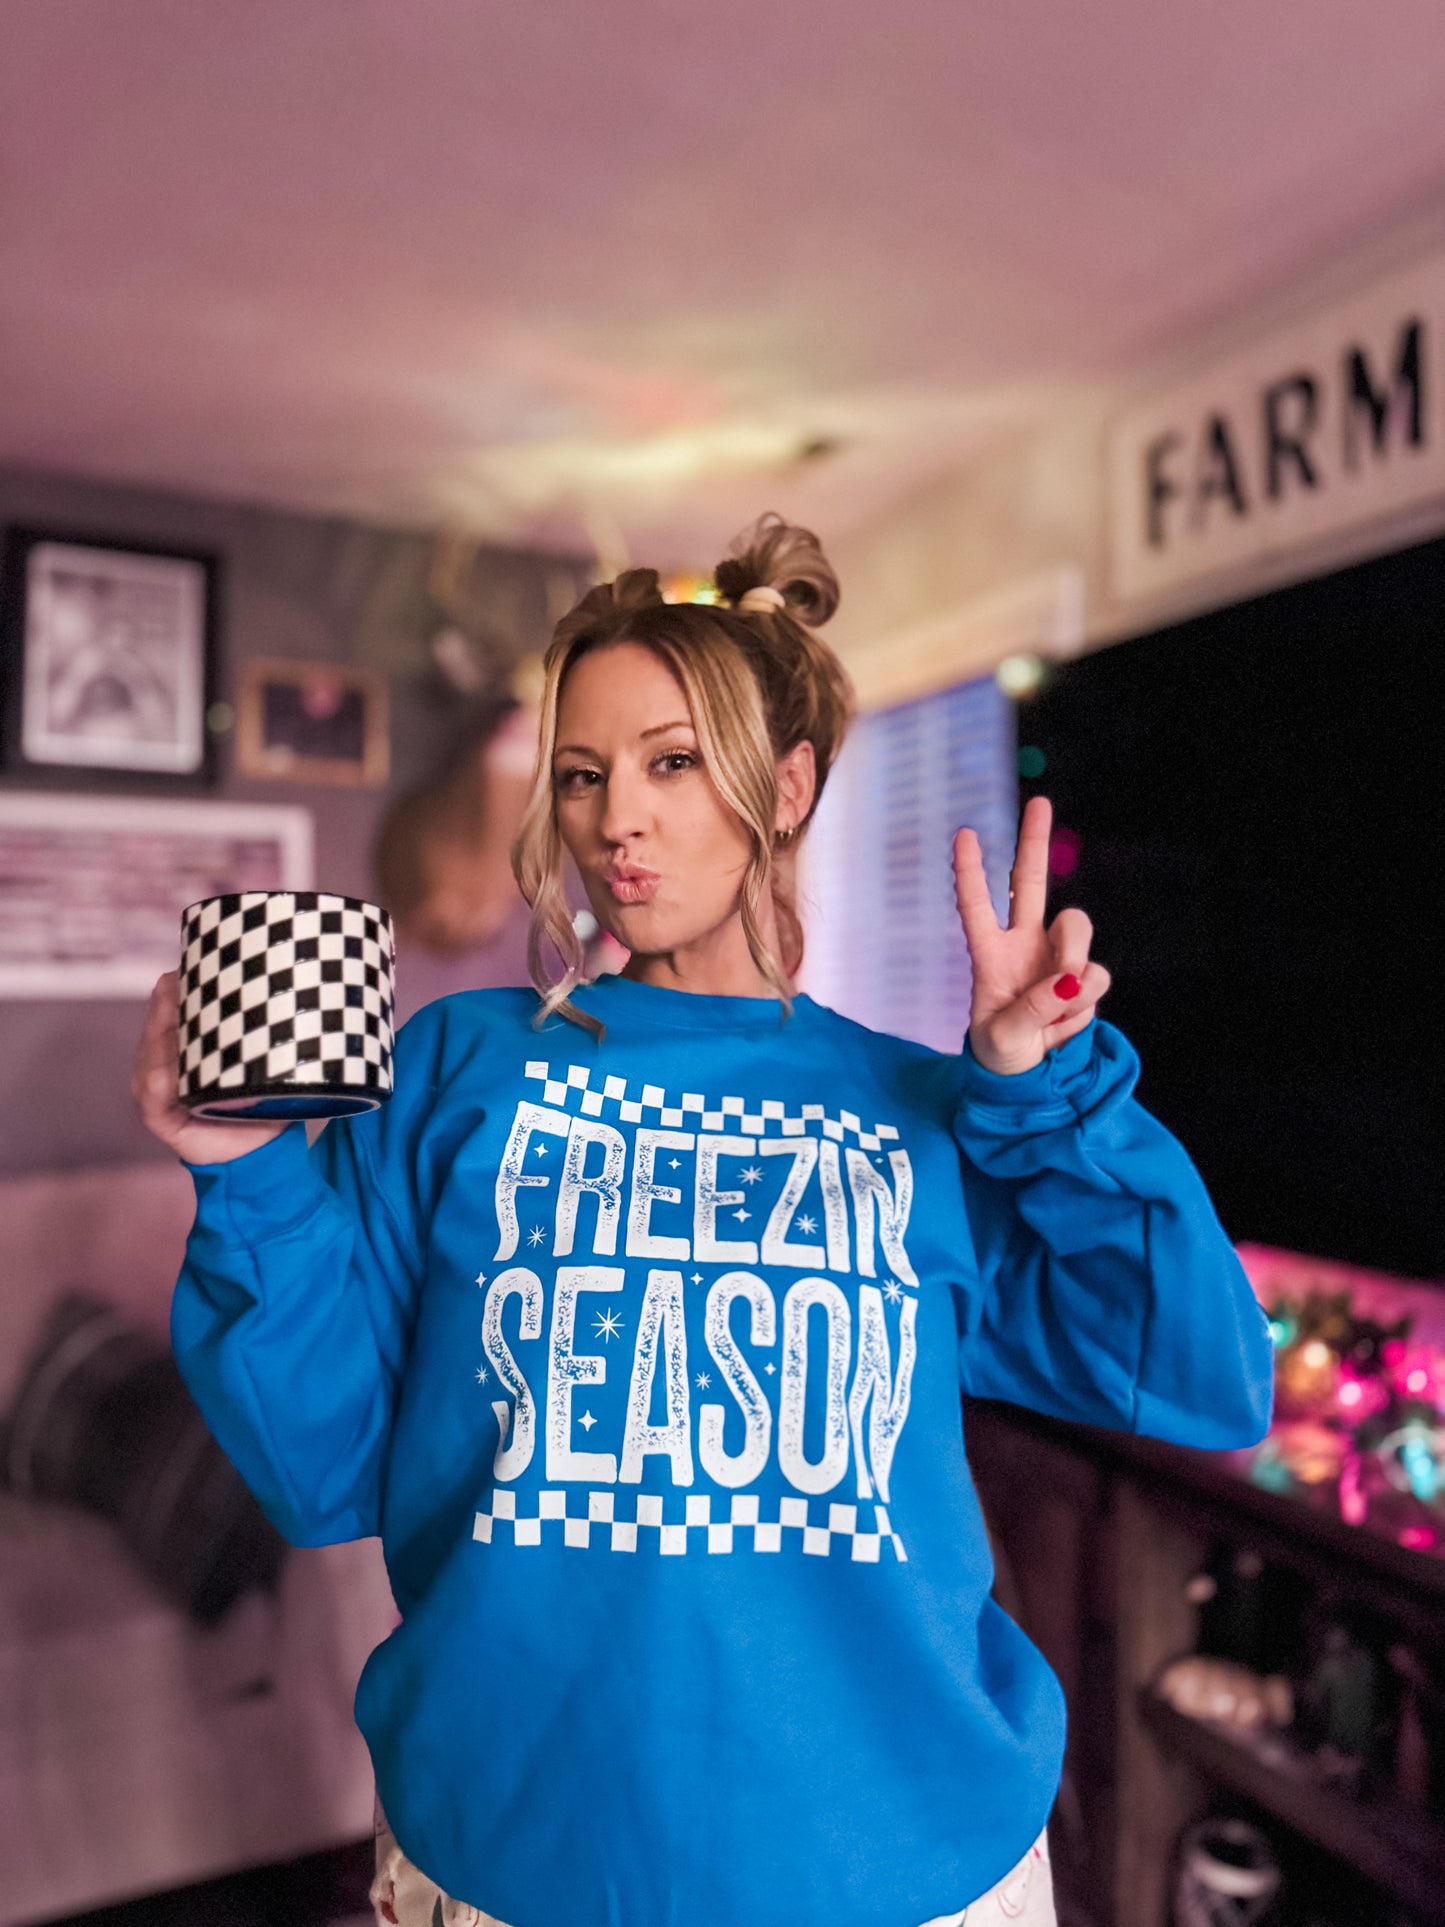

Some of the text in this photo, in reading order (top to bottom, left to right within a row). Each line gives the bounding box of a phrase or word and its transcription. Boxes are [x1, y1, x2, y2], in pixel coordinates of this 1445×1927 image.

[1144, 316, 1423, 549] FARM
[493, 1101, 919, 1287] FREEZIN
[481, 1266, 918, 1503] SEASON
